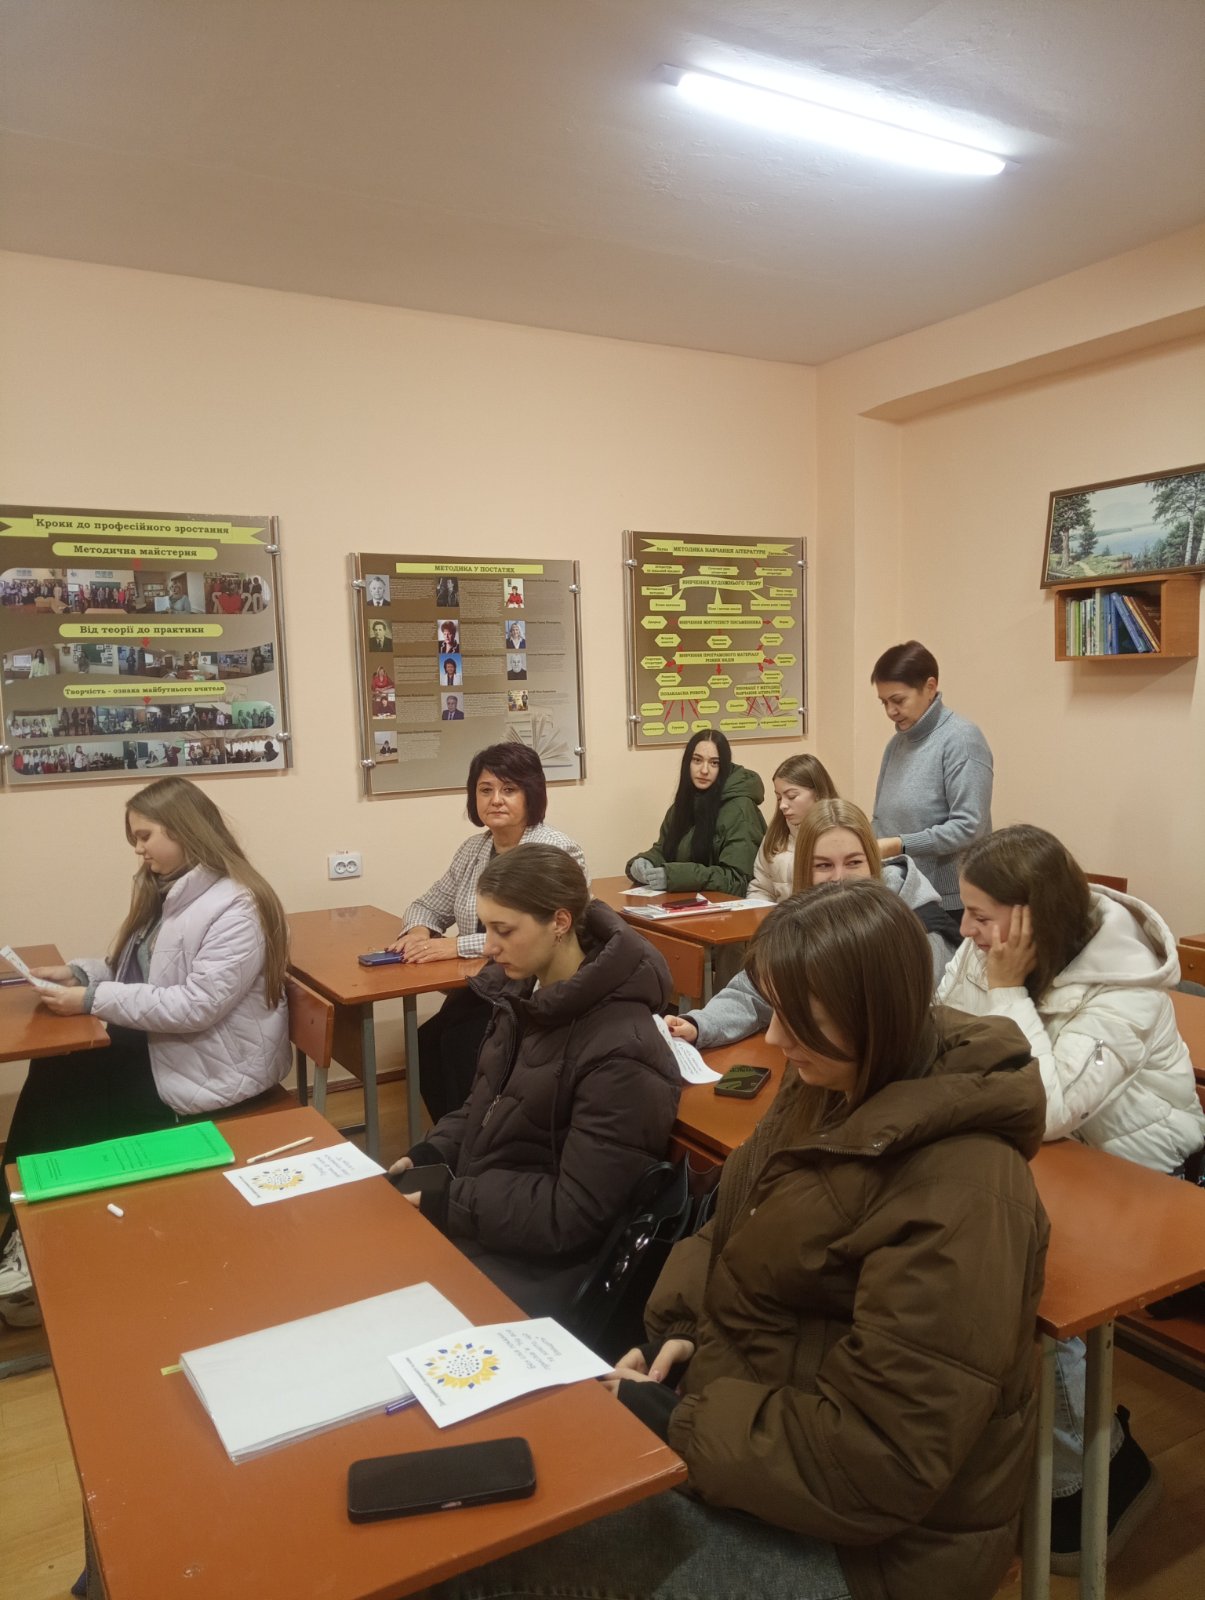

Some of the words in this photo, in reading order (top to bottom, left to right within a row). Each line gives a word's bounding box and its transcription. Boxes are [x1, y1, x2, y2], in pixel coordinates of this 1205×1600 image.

[36, 518, 73, 529] Кроки
[94, 522, 171, 532] професійного
[174, 525, 229, 535] зростання
[73, 545, 136, 555] Методична
[140, 547, 197, 558] майстерня
[79, 625, 98, 634] Від
[101, 625, 134, 635] теорії
[137, 626, 151, 634] до
[154, 627, 204, 635] практики
[65, 688, 106, 696] Творчість
[142, 686, 193, 694] майбутнього
